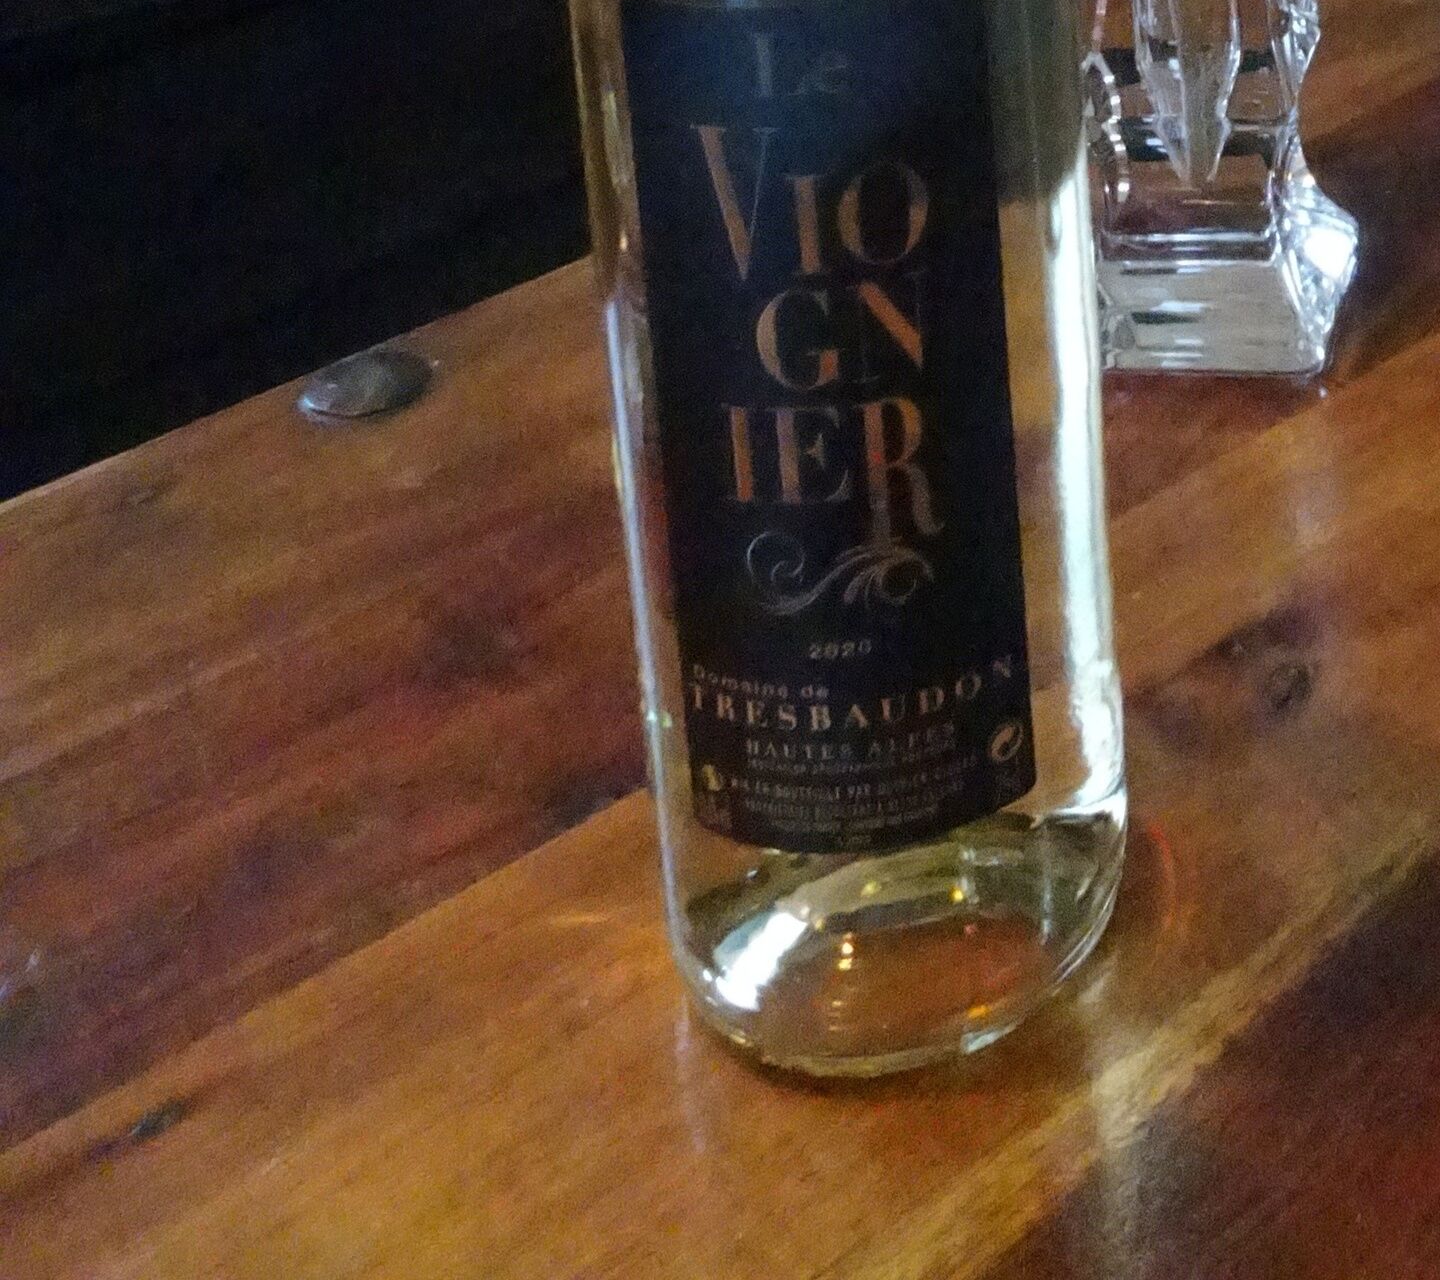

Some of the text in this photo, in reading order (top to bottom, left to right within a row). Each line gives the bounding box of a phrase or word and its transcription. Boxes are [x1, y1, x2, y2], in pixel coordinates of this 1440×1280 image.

[690, 124, 930, 282] VIO
[809, 639, 873, 661] 2020
[688, 654, 1014, 732] TRESBAUDON
[693, 663, 789, 700] Domaine
